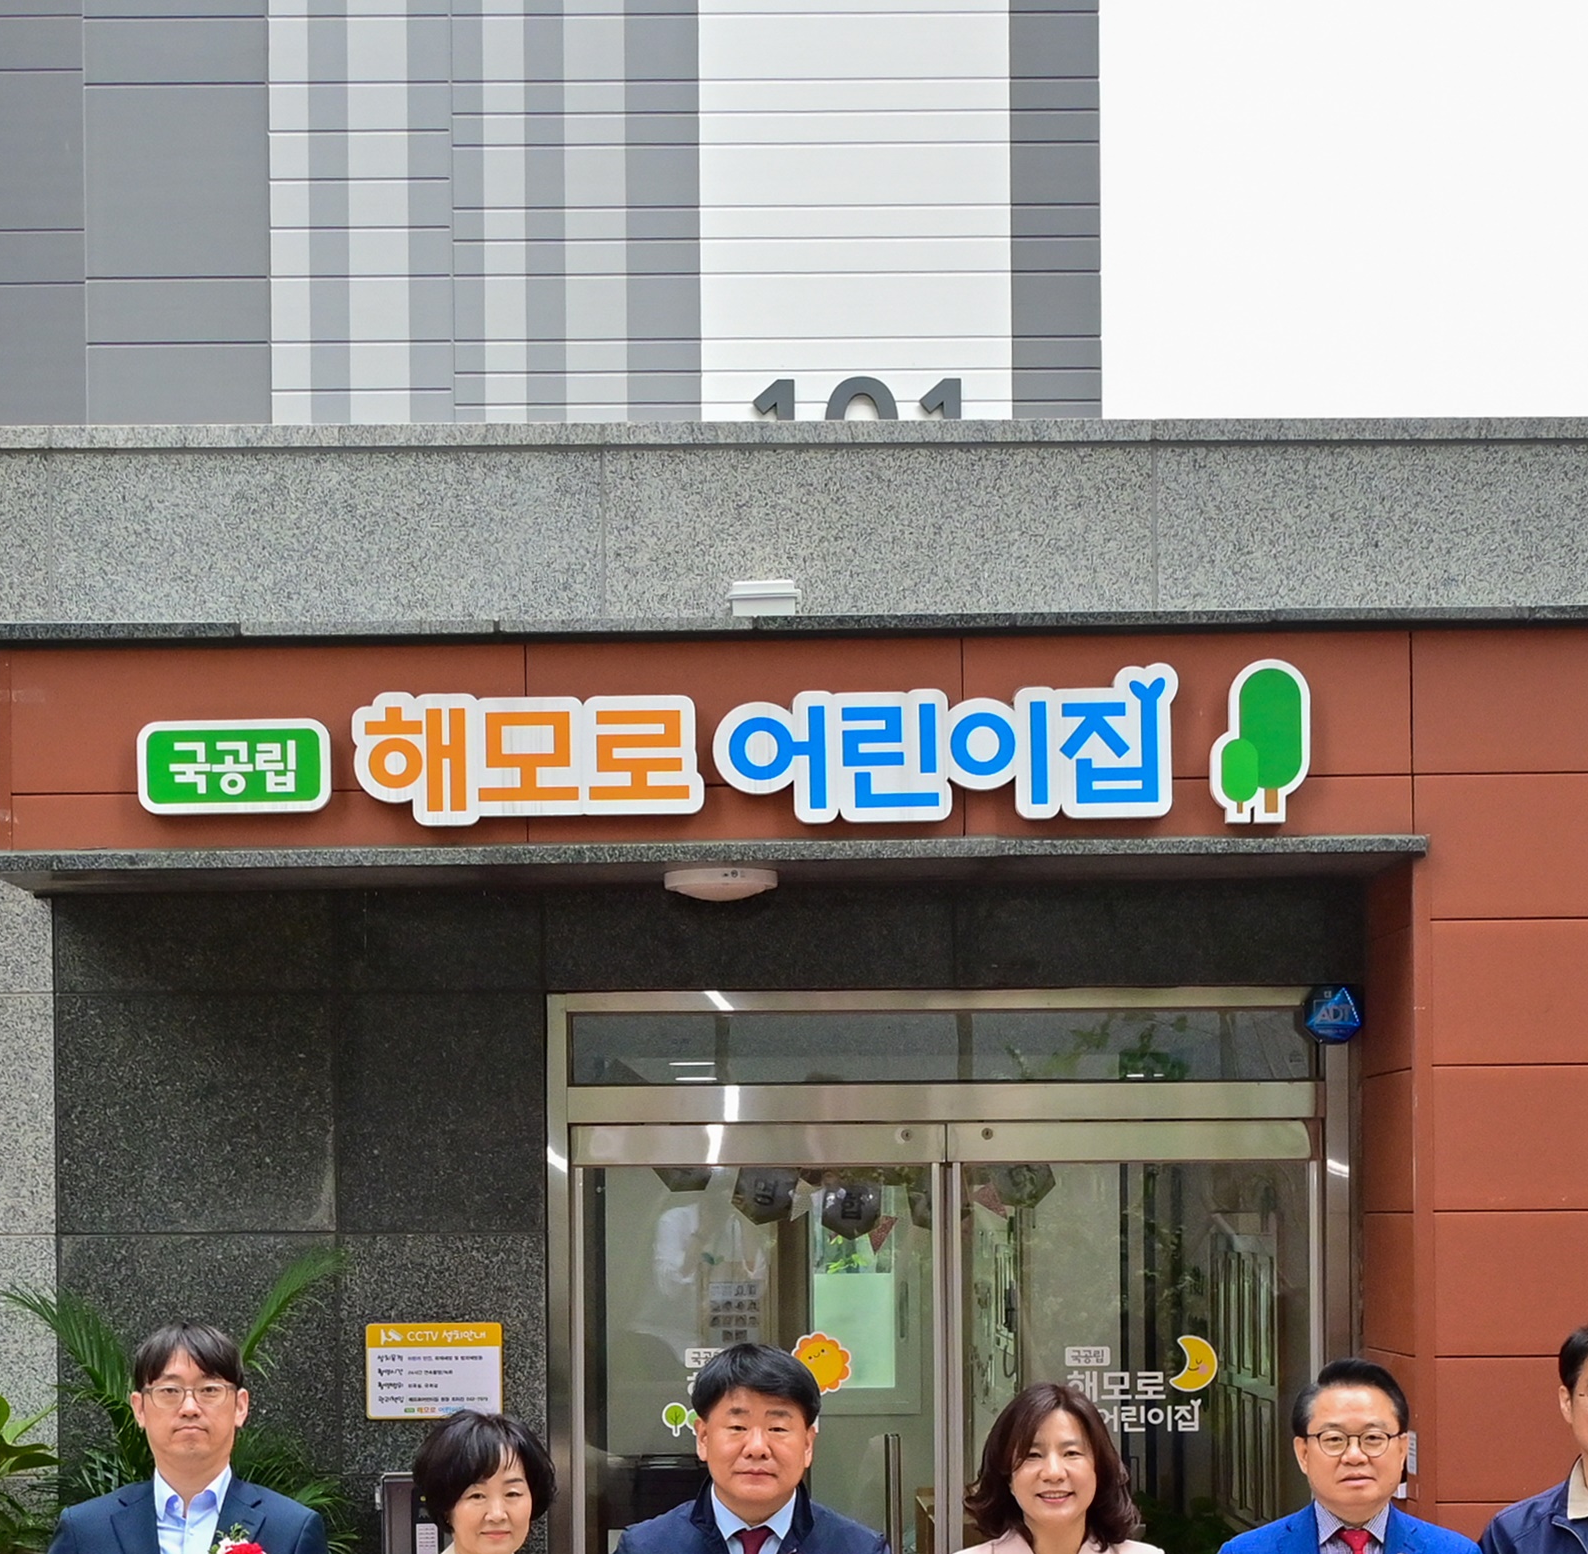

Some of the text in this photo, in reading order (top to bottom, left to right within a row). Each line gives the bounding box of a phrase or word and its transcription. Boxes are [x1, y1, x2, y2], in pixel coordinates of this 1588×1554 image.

[168, 676, 1166, 813] 국공립 해모로 어린이집
[1315, 1004, 1352, 1023] ADT
[407, 1329, 487, 1342] CCTV 설치안내
[691, 1351, 722, 1365] 국공
[1071, 1350, 1104, 1364] 국공립
[1067, 1370, 1167, 1402] 해모로
[1098, 1398, 1202, 1432] 어린이집
